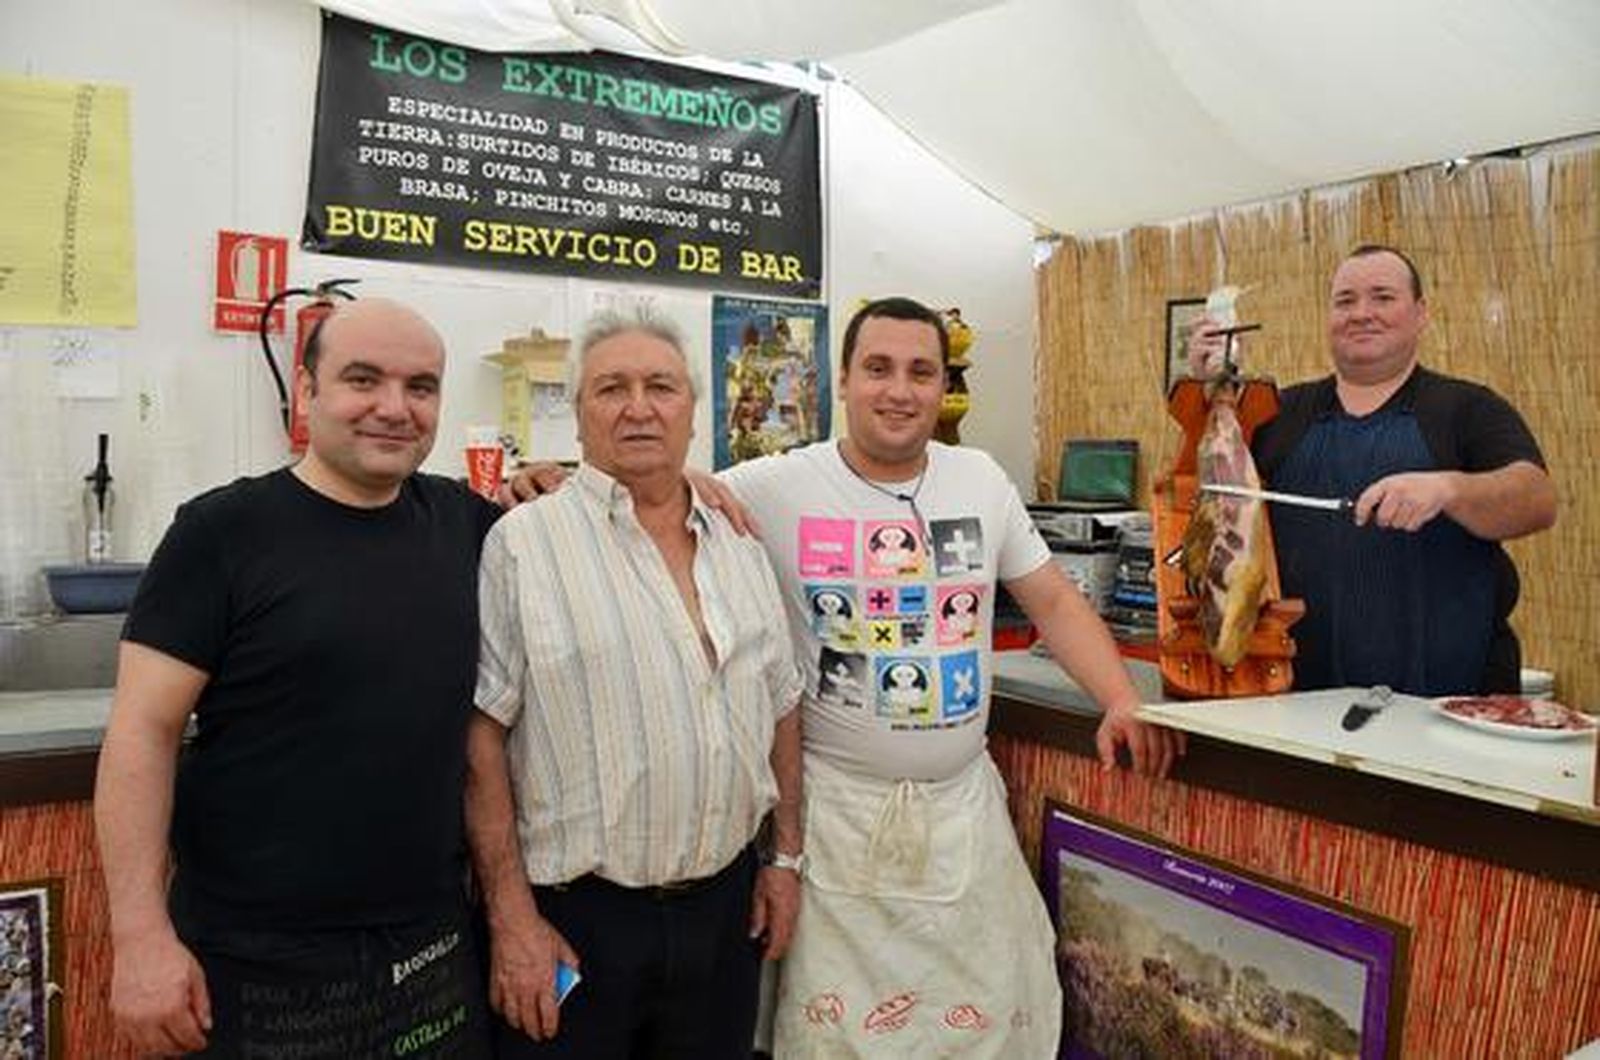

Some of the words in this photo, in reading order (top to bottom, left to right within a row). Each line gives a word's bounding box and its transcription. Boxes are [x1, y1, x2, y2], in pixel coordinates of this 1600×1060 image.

[369, 33, 467, 83] LOS
[501, 58, 782, 135] EXTREMEÑOS
[388, 96, 549, 135] ESPECIALIDAD
[559, 122, 585, 142] EN
[596, 130, 698, 160] PRODUCTOS
[709, 148, 733, 163] DE
[742, 151, 764, 168] LA
[358, 147, 430, 171] PUROS
[442, 157, 470, 175] DE
[482, 163, 548, 186] OVEJA
[558, 172, 572, 189] Y
[666, 186, 732, 210] CARNES
[740, 197, 753, 213] A
[761, 202, 783, 217] LA
[400, 177, 479, 204] BRASA;
[496, 189, 608, 218] PINCHITOS
[619, 204, 699, 229] MORUNOS
[708, 217, 750, 235] etc.
[571, 150, 595, 167] DE
[720, 171, 782, 195] QUESOS
[325, 205, 438, 247] BUEN
[464, 219, 657, 267] SERVICIO
[678, 243, 721, 274] DE
[741, 250, 804, 282] BAR
